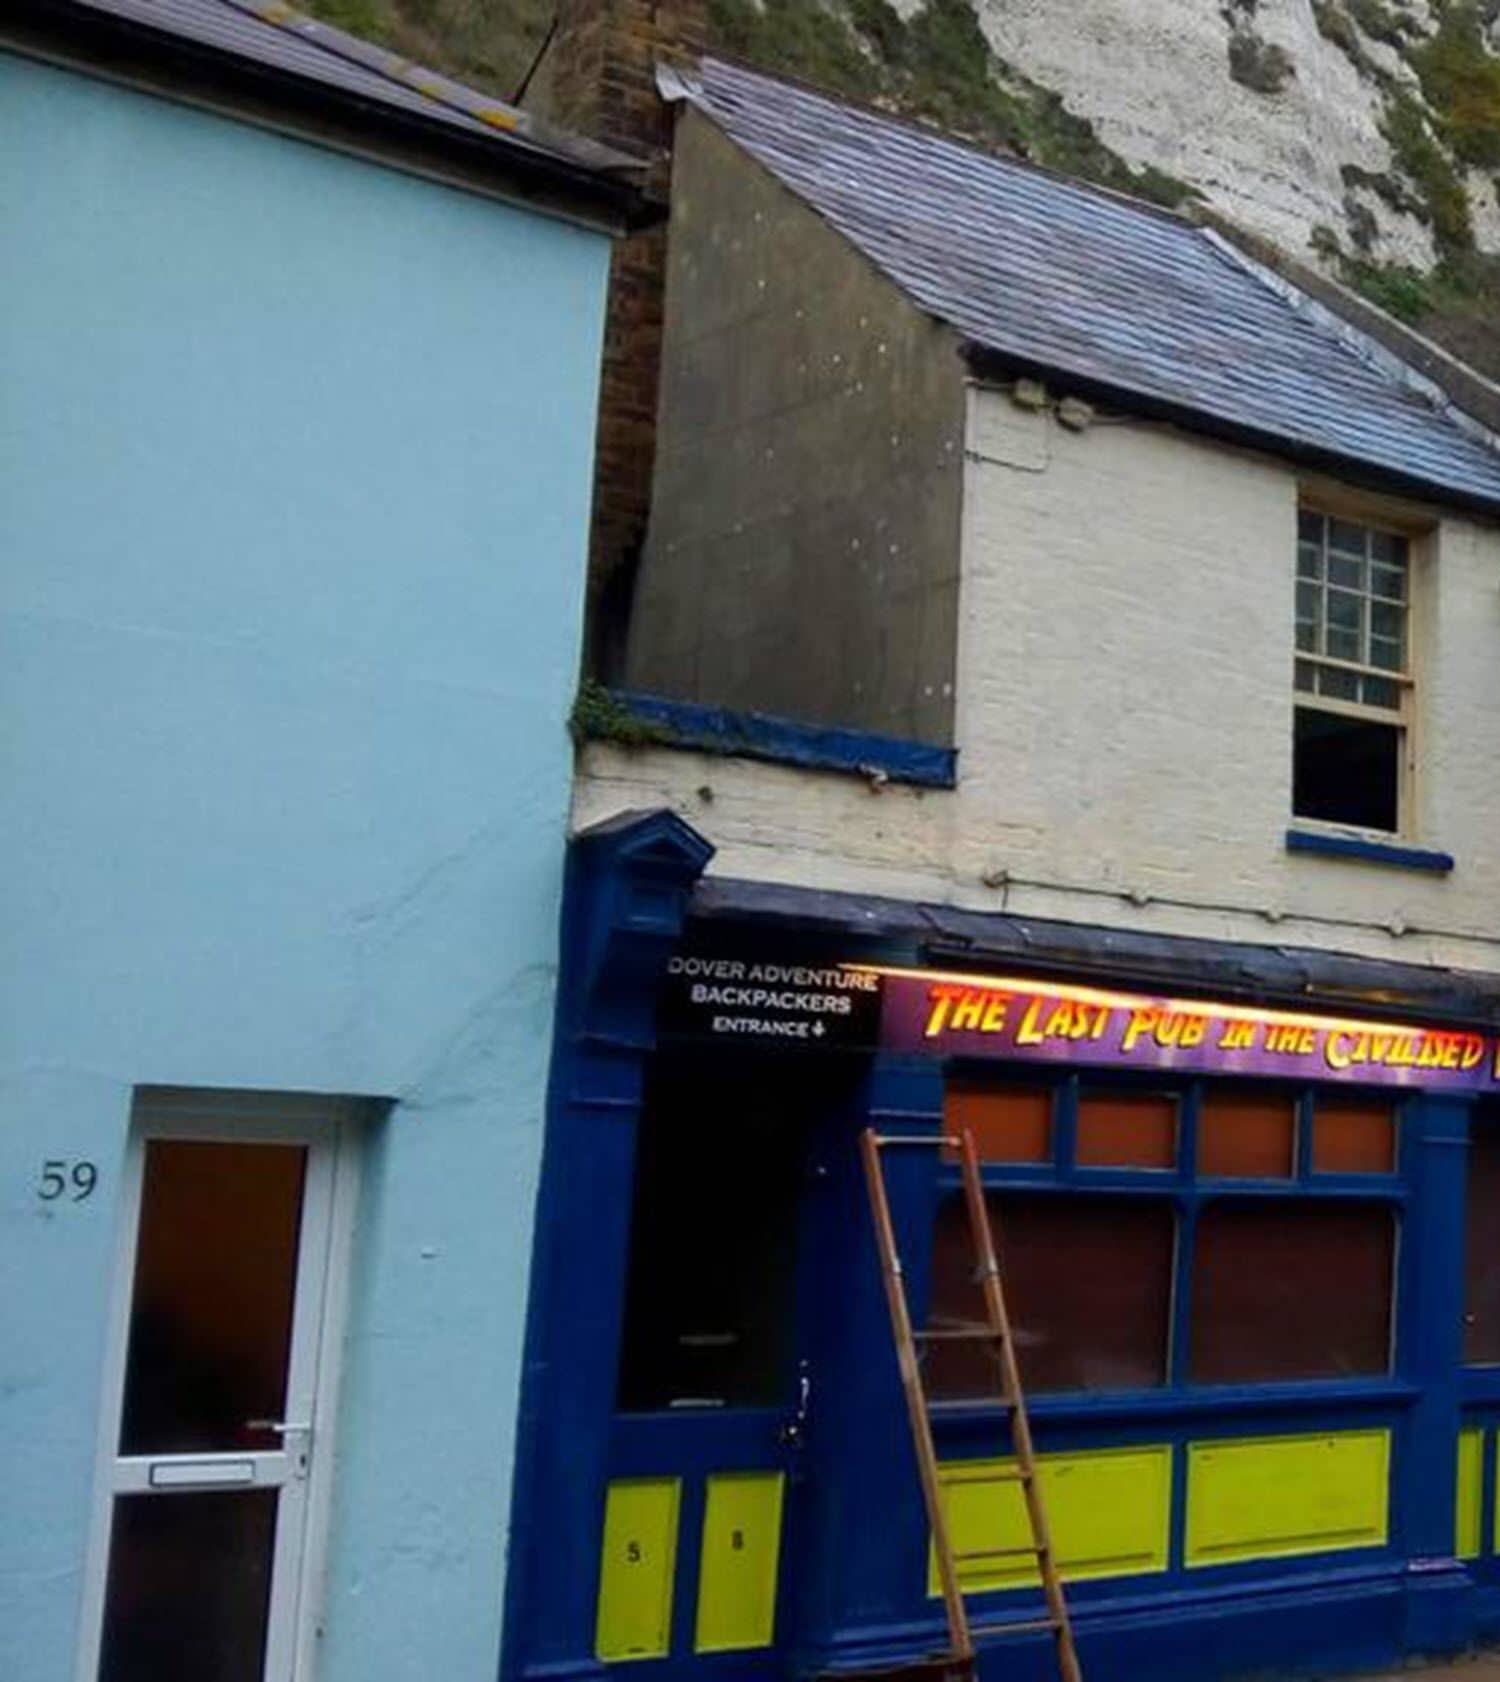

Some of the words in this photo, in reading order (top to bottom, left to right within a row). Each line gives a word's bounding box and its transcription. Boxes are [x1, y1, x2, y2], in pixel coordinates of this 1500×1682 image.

[667, 957, 746, 979] DOVER
[749, 966, 878, 991] ADVENTURE
[691, 984, 851, 1014] BACKPACKERS
[712, 1016, 809, 1037] ENTRANCE
[924, 984, 1013, 1038] THE
[1015, 996, 1112, 1045] LAST
[1121, 1009, 1211, 1051] PUB
[1218, 1019, 1257, 1048] IN
[1263, 1025, 1316, 1053] THE
[1325, 1029, 1485, 1070] CIVILISED
[37, 1161, 97, 1201] 59
